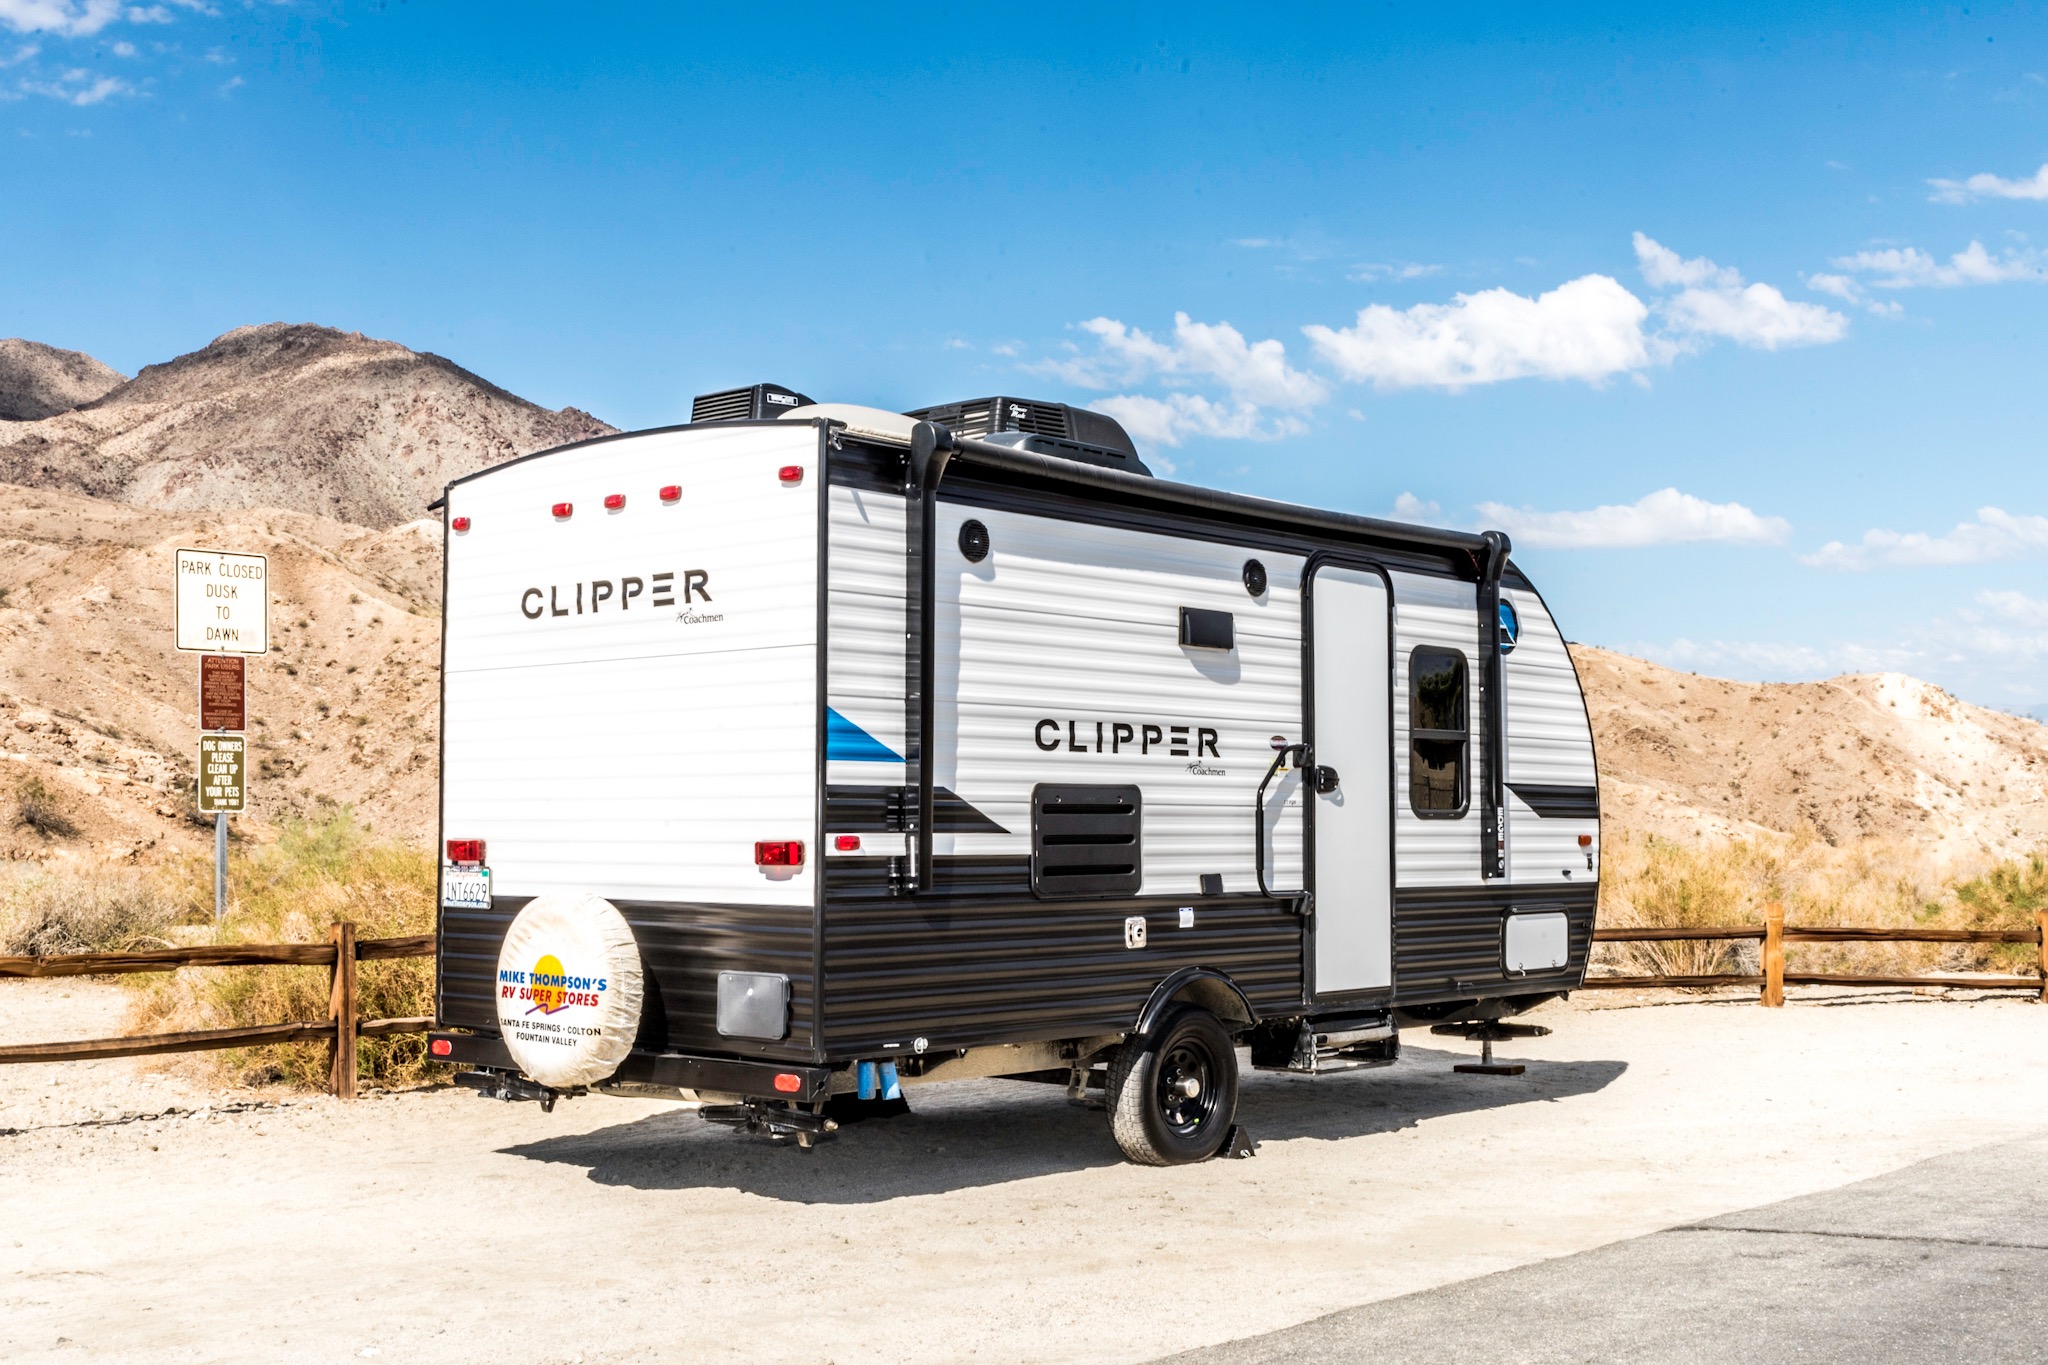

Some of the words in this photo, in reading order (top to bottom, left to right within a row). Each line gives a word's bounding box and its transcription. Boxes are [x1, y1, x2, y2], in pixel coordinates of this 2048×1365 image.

[181, 560, 211, 575] PARK
[219, 563, 263, 580] CLOSED
[206, 583, 238, 599] DUSK
[521, 569, 713, 619] CLIPPER
[216, 605, 230, 620] TO
[683, 613, 724, 625] Coachmen
[206, 626, 239, 642] DAWN
[207, 657, 239, 665] ATTENTION
[1035, 718, 1221, 758] CLIPPER
[202, 740, 216, 752] DOG
[217, 740, 243, 752] OWNERS
[211, 752, 235, 763] PLEASE
[207, 763, 228, 775] CLEAN
[229, 763, 239, 775] UP
[1192, 766, 1226, 776] Coachmen
[213, 775, 233, 786] AFTER
[205, 786, 223, 797] YOUR
[224, 786, 240, 797] PETS
[446, 881, 488, 902] 1NT6629
[499, 970, 525, 984] MIKE
[529, 973, 607, 992] THOMPSON'S
[501, 985, 516, 999] RV
[520, 987, 552, 1002] SUPER
[556, 991, 599, 1007] STORES
[521, 1020, 530, 1029] FE
[531, 1022, 561, 1033] SPRINGS
[567, 1026, 602, 1036] COLTON
[516, 1032, 550, 1044] FOUNTAIN
[551, 1036, 578, 1047] VALLEY
